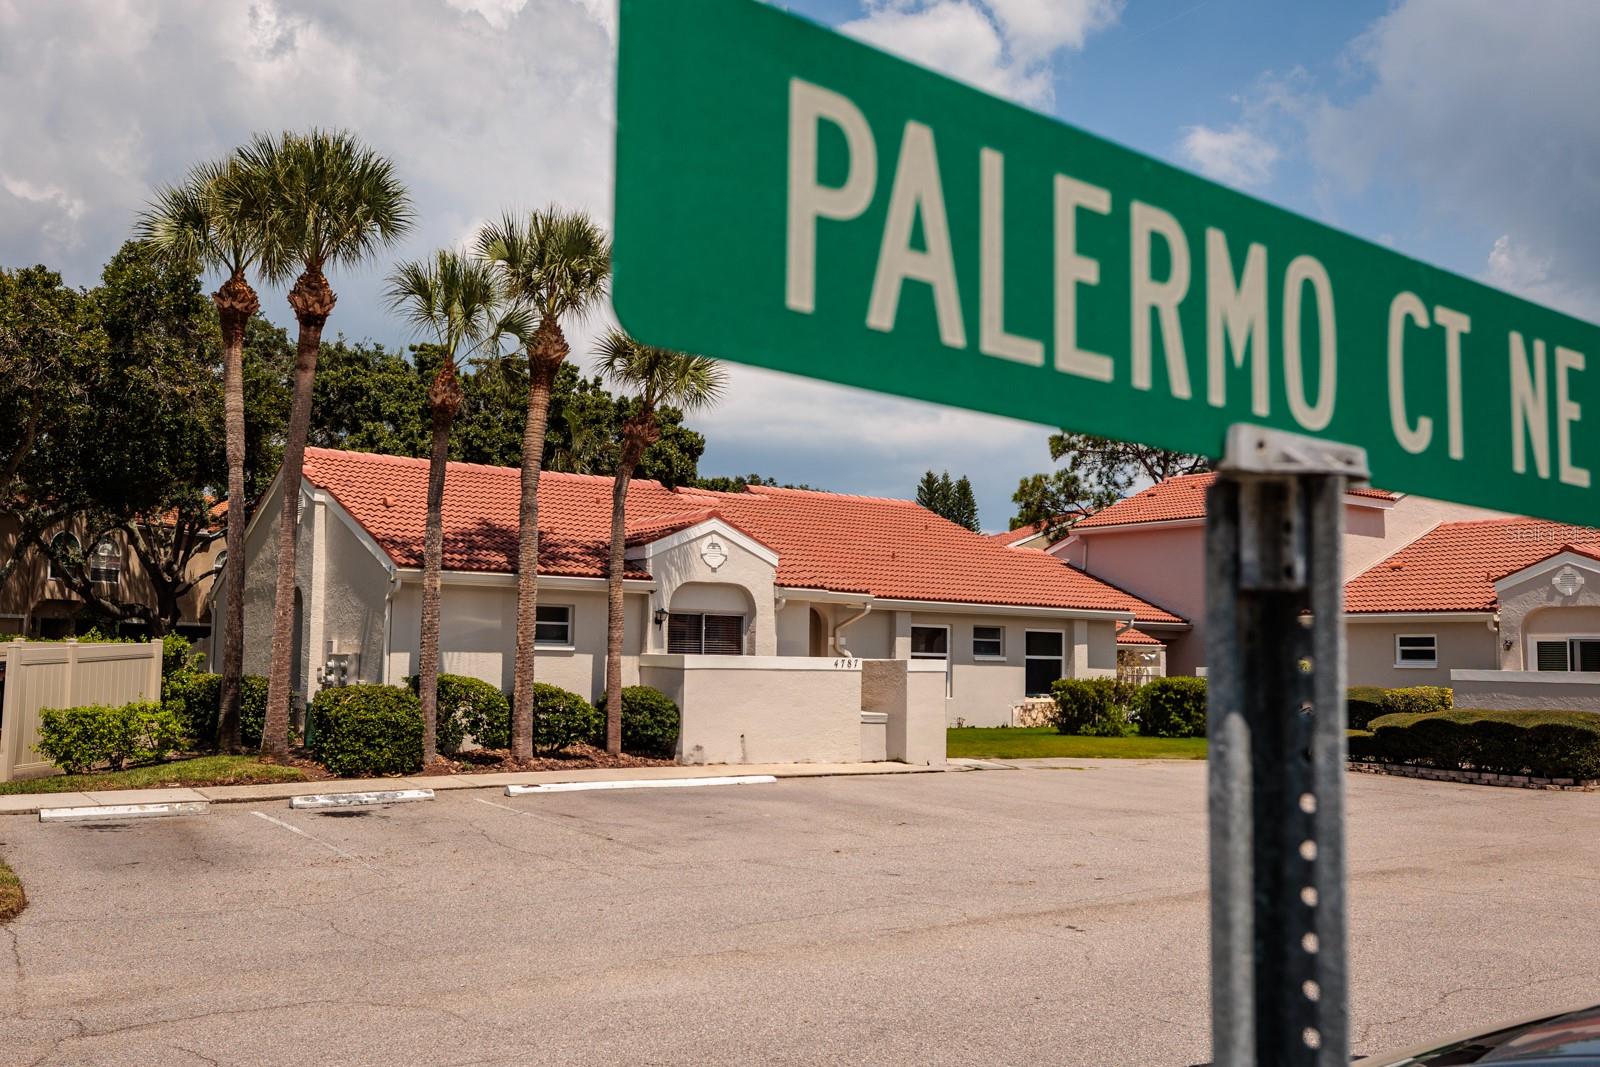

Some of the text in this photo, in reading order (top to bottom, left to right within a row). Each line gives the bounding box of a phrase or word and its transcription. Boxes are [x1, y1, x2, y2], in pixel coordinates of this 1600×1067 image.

[785, 78, 1590, 488] PALERMO CT NE
[834, 659, 859, 669] 4787
